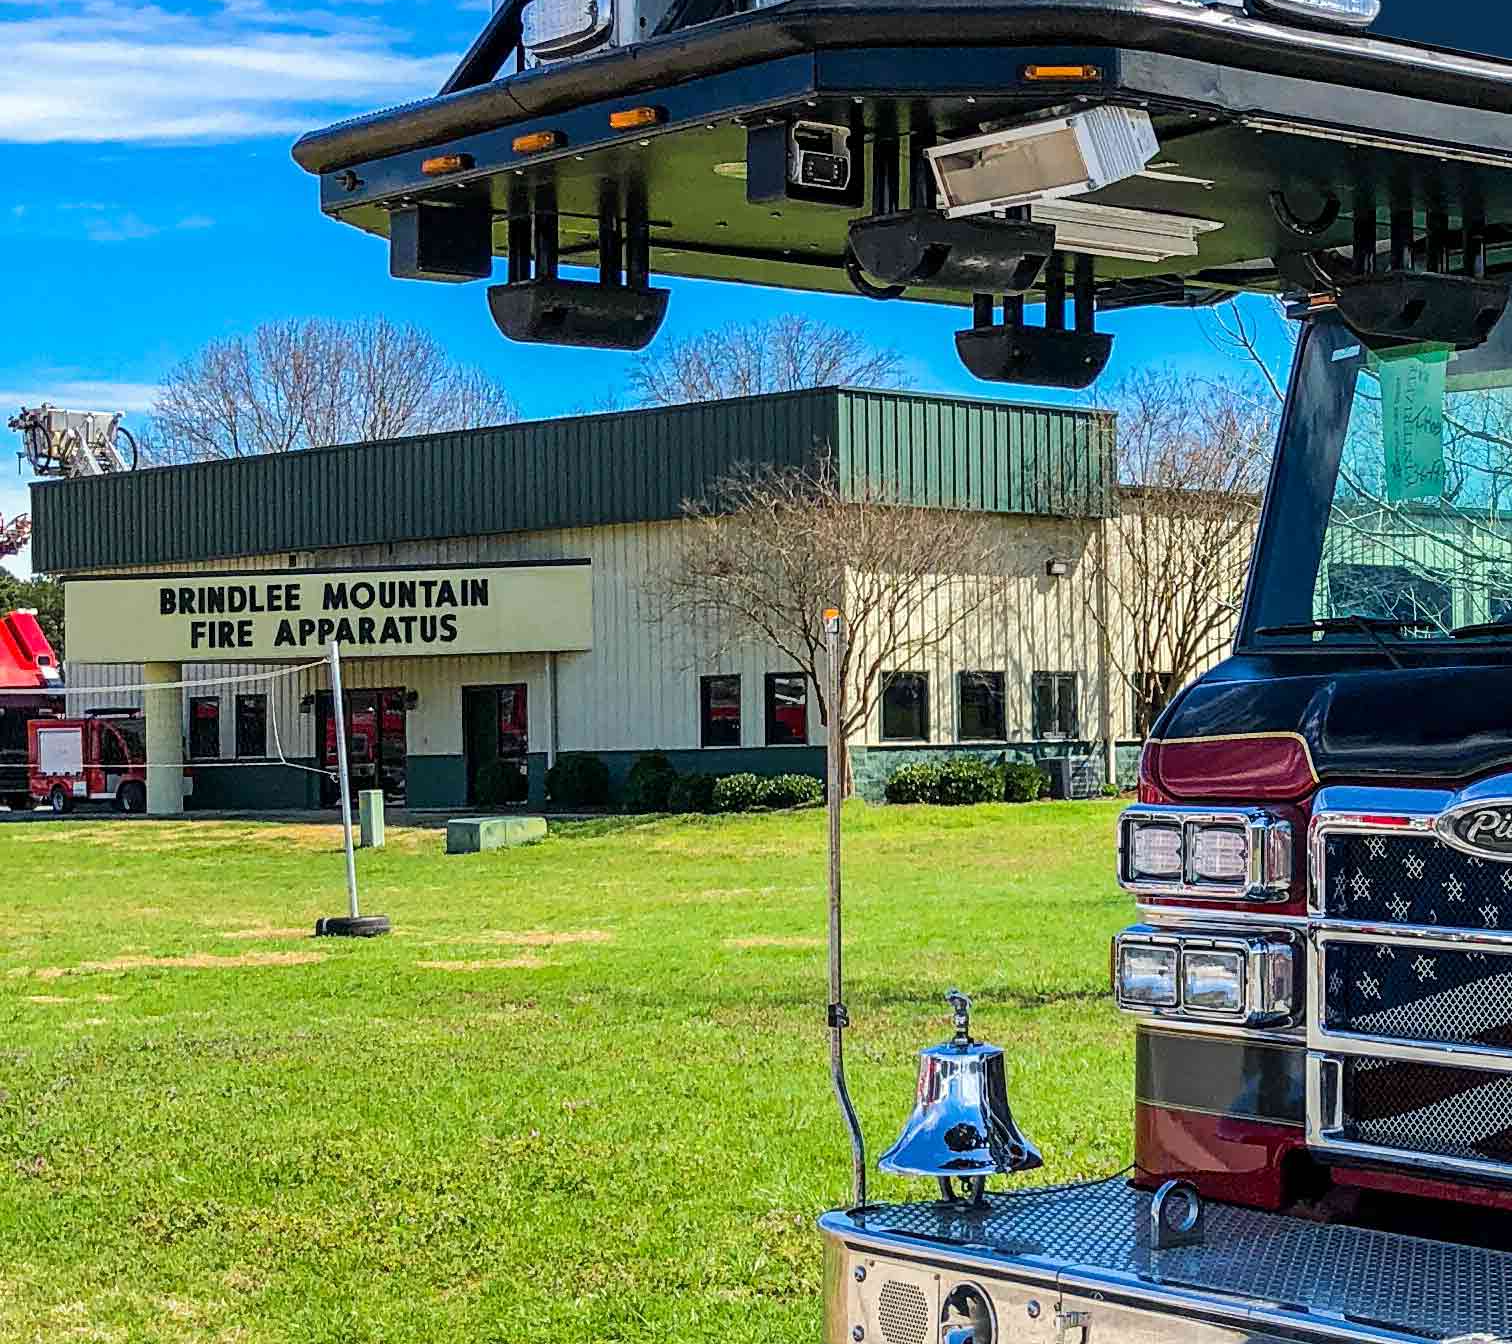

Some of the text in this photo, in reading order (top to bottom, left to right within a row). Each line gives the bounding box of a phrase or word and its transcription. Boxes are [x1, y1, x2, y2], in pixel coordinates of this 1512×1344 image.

[159, 578, 489, 615] BRINDLEE MOUNTAIN
[190, 613, 458, 649] FIRE APPARATUS
